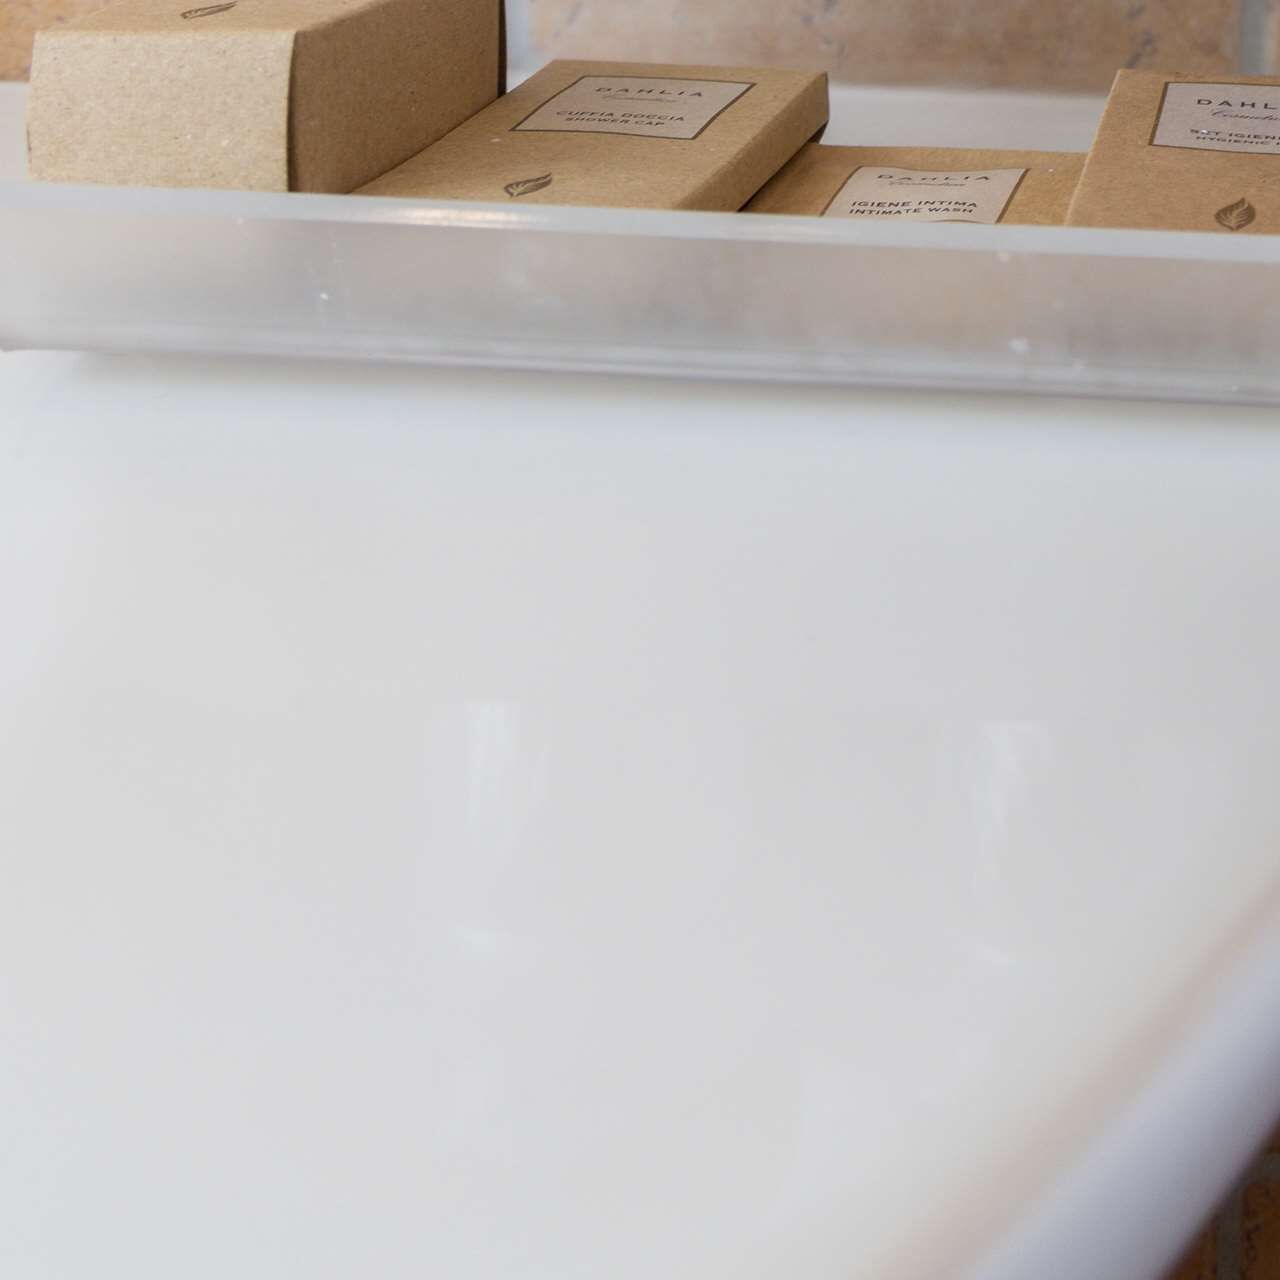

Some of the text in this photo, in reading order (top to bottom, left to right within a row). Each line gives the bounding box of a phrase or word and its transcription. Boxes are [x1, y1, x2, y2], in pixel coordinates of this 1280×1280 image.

[595, 87, 704, 97] DAHLIA
[565, 116, 630, 124] SHOWER
[620, 112, 685, 122] DOCCIA
[1195, 136, 1270, 145] HYGIENIC
[851, 200, 978, 208] IGIENE INTIMA
[849, 207, 923, 215] INTIMATE
